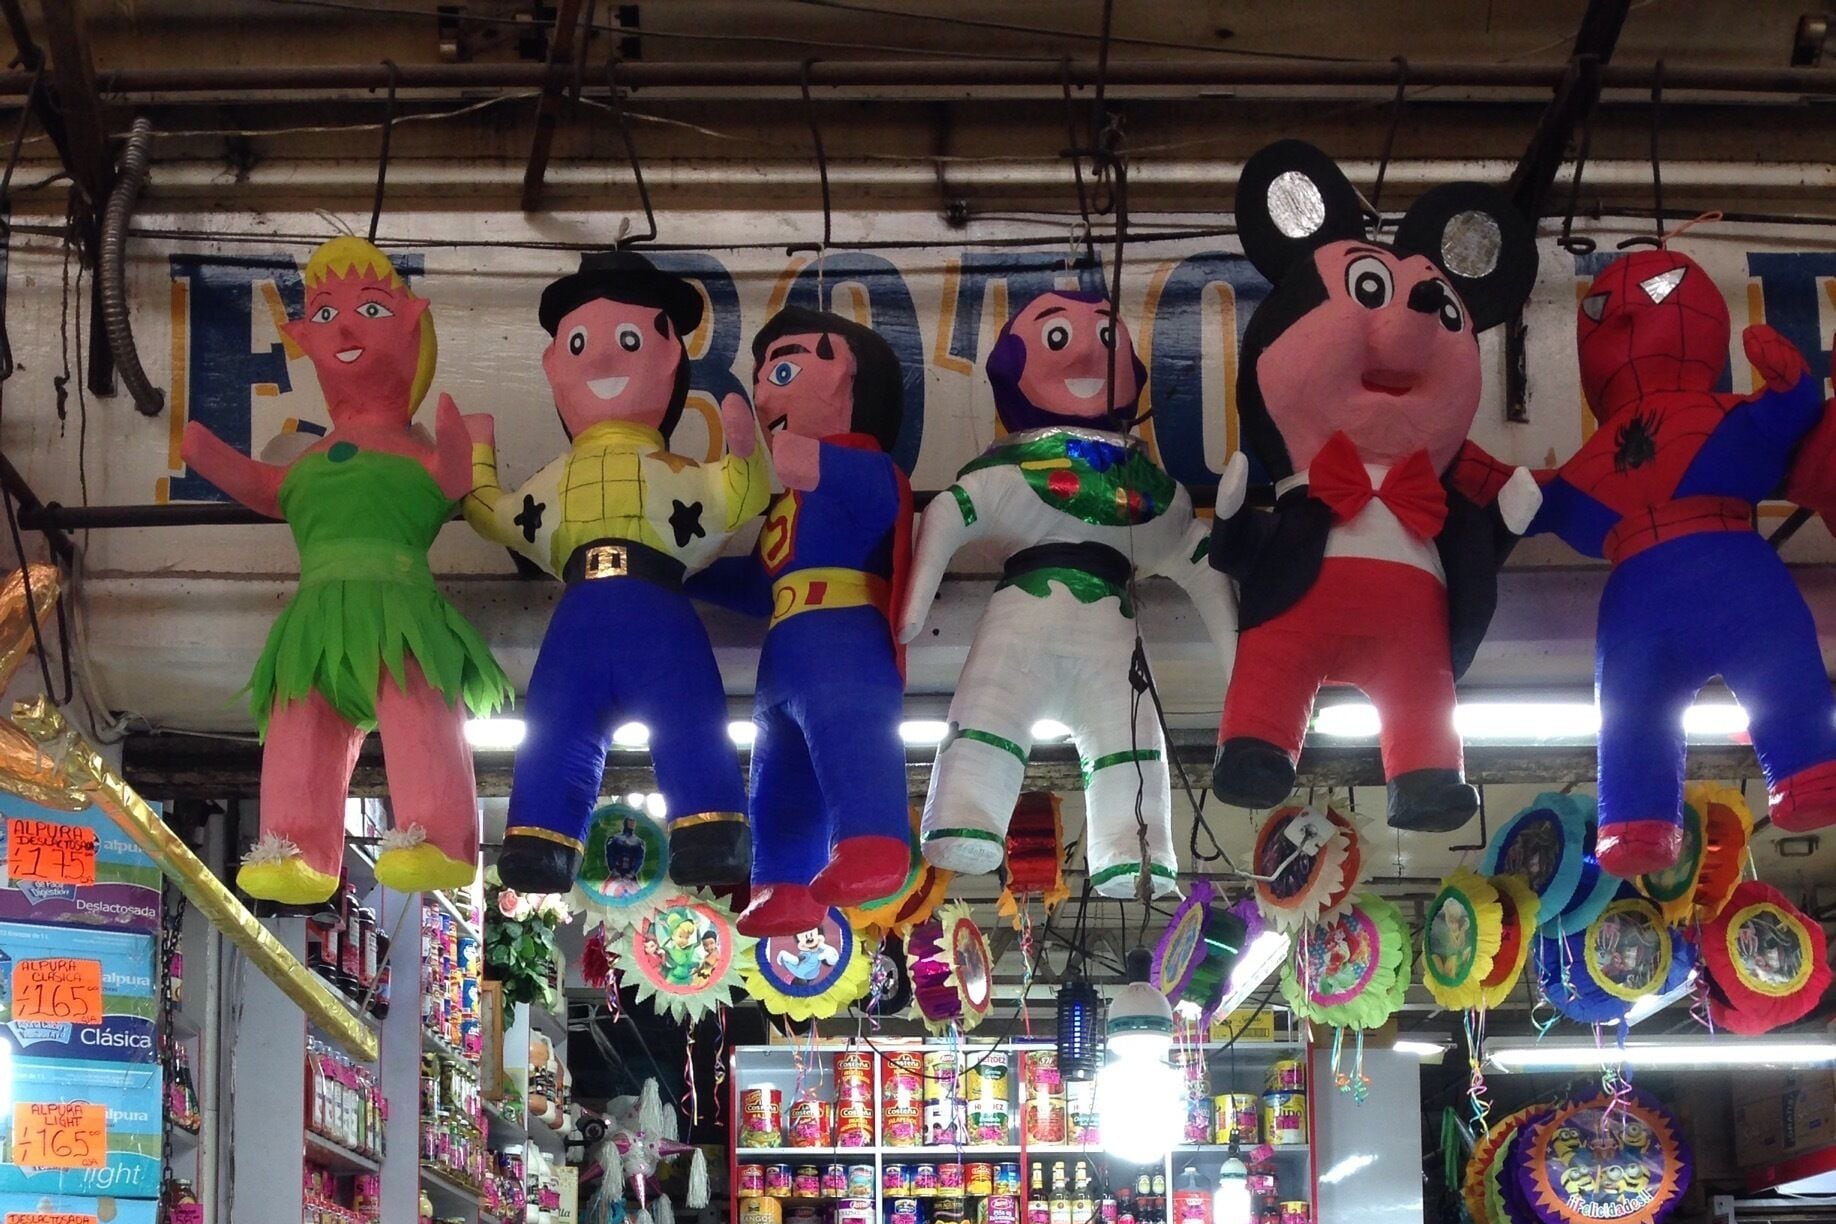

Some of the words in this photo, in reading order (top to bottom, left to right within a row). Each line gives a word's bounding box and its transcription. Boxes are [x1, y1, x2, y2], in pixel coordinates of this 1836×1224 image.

[14, 820, 83, 840] ALPURA
[103, 840, 143, 854] alpu
[21, 846, 85, 880] 175
[76, 899, 156, 917] Deslactosada
[21, 961, 76, 971] ALPURA
[103, 974, 150, 988] alpura
[29, 984, 89, 1017] 165
[80, 1028, 152, 1048] Clásica
[31, 1103, 83, 1117] ALPURA
[44, 1116, 82, 1128] LIGHT
[37, 1129, 89, 1157] 165
[84, 1162, 142, 1188] light
